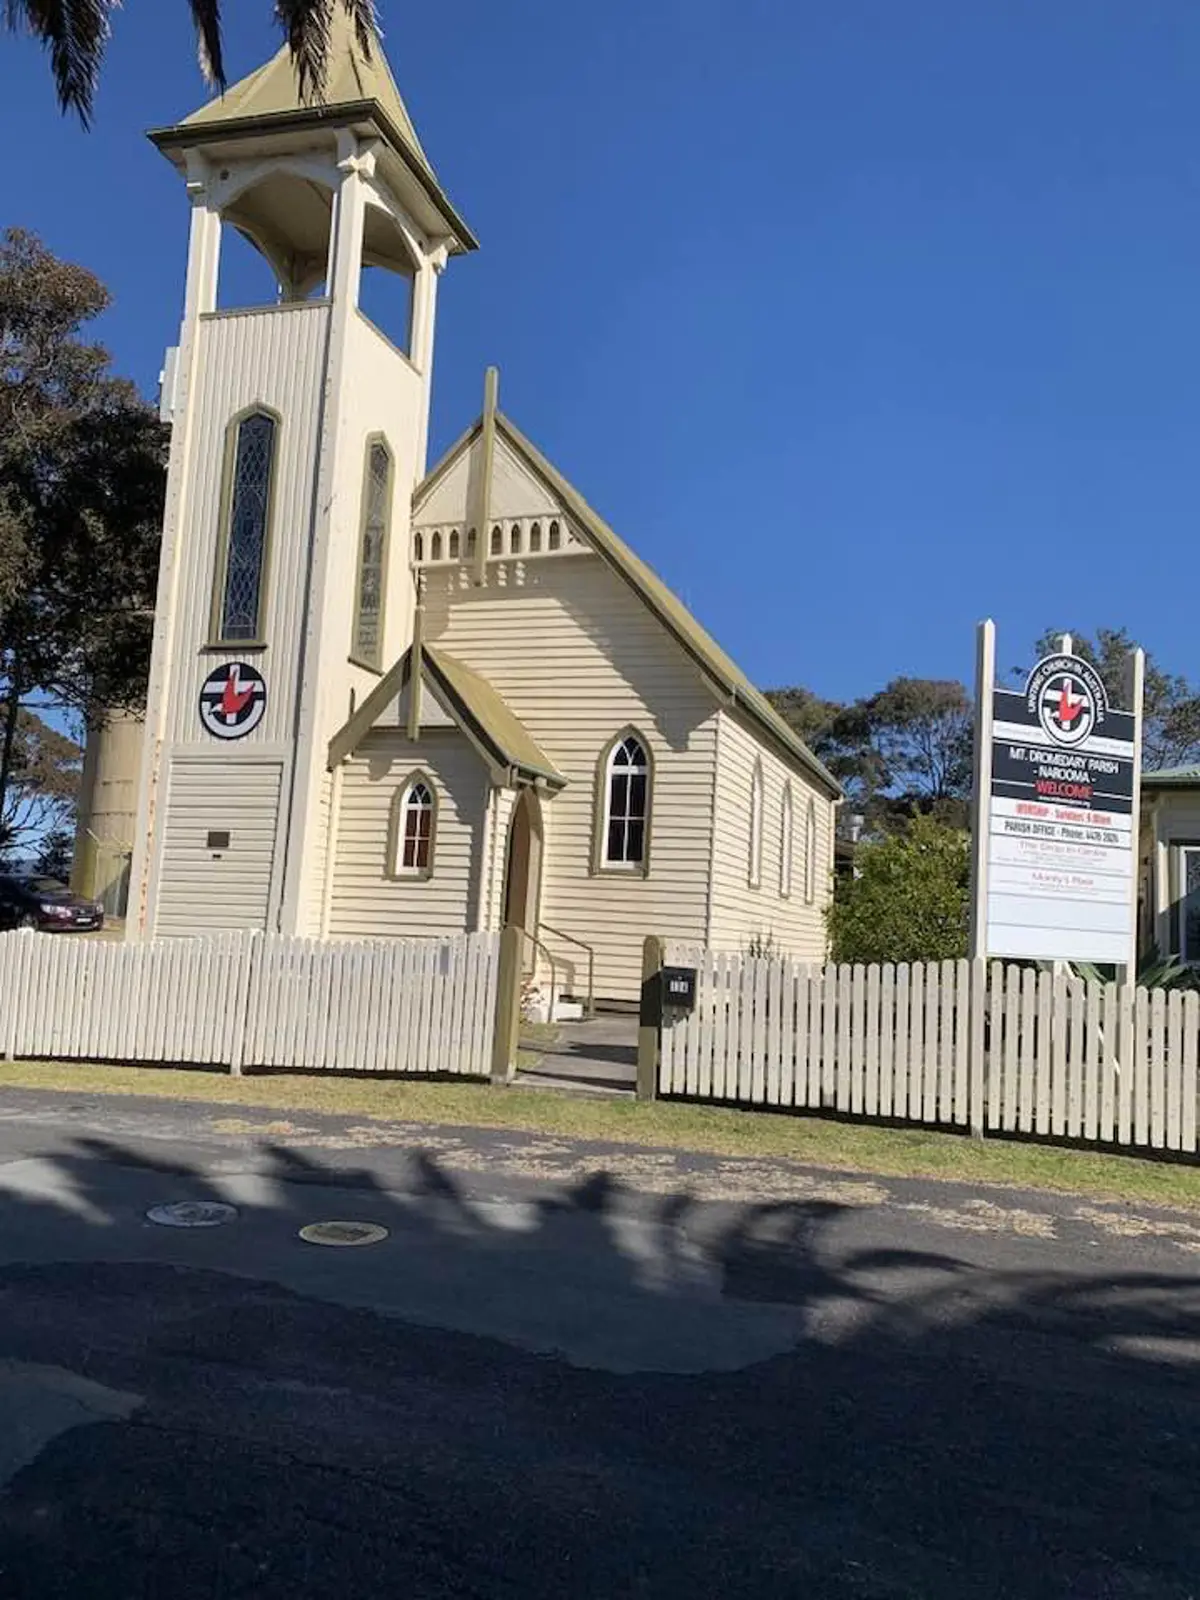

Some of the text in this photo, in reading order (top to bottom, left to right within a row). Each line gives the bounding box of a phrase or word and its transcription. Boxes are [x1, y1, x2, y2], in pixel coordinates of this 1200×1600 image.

[1027, 672, 1045, 713] UNITING
[1041, 659, 1074, 675] CHURCH
[1082, 669, 1105, 723] AUSTRALIA
[1009, 746, 1119, 774] MT. DROMEDARY PARISH
[1038, 765, 1090, 783] NAROOMA
[1036, 781, 1093, 798] WELCOME
[1015, 802, 1049, 816] WORSHIP
[1004, 820, 1031, 834] PARISH
[1032, 823, 1056, 837] OFFICE
